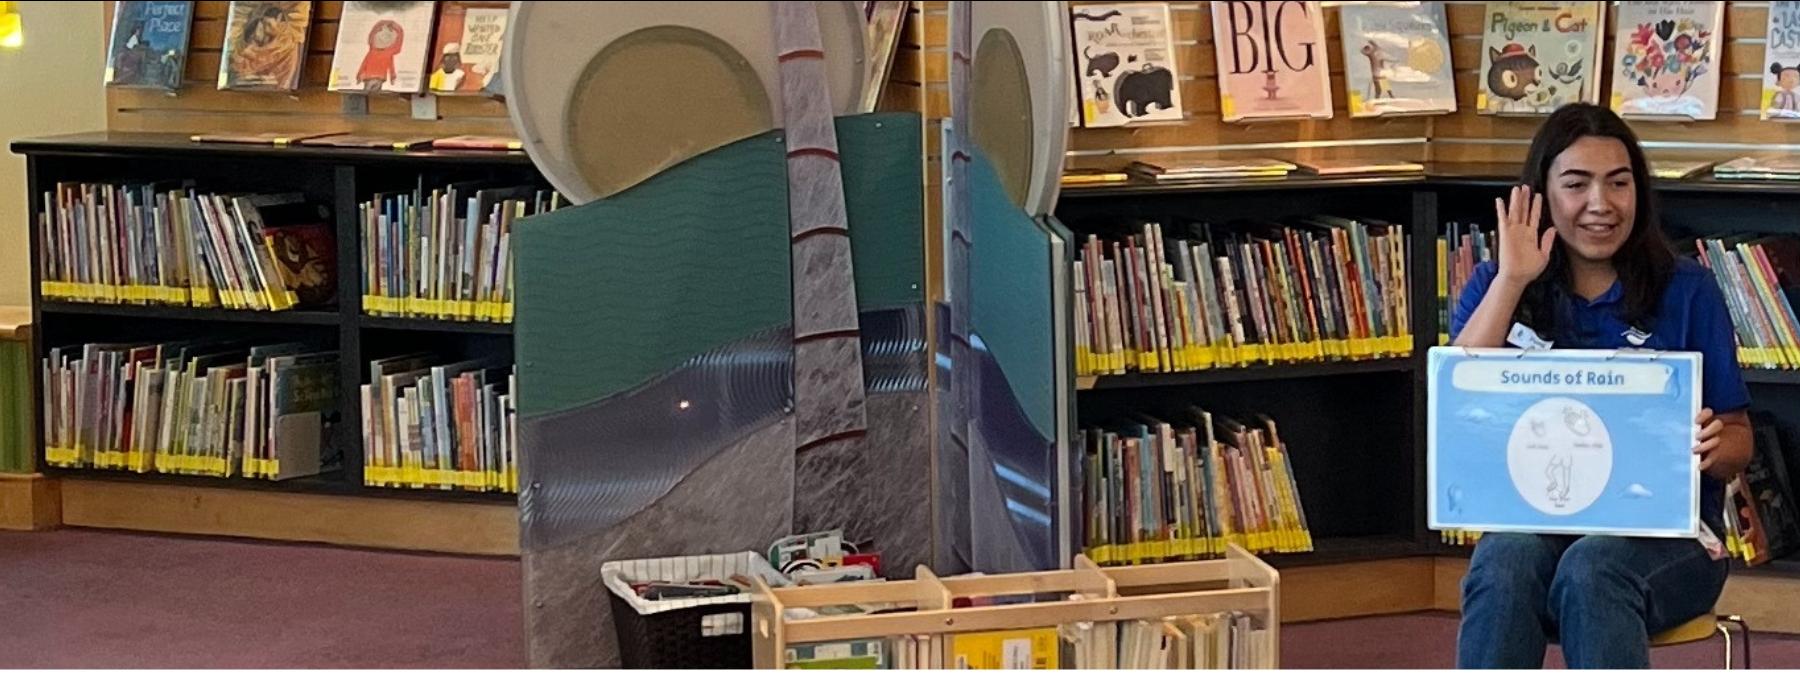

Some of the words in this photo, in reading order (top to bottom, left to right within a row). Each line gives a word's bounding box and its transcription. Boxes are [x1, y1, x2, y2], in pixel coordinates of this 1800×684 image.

[146, 17, 181, 33] Place
[1490, 12, 1538, 40] Pigeon
[1555, 13, 1588, 33] Cat
[1224, 1, 1316, 74] BIG
[1500, 370, 1561, 385] Sounds
[1565, 370, 1583, 385] of
[1587, 370, 1626, 386] Rain
